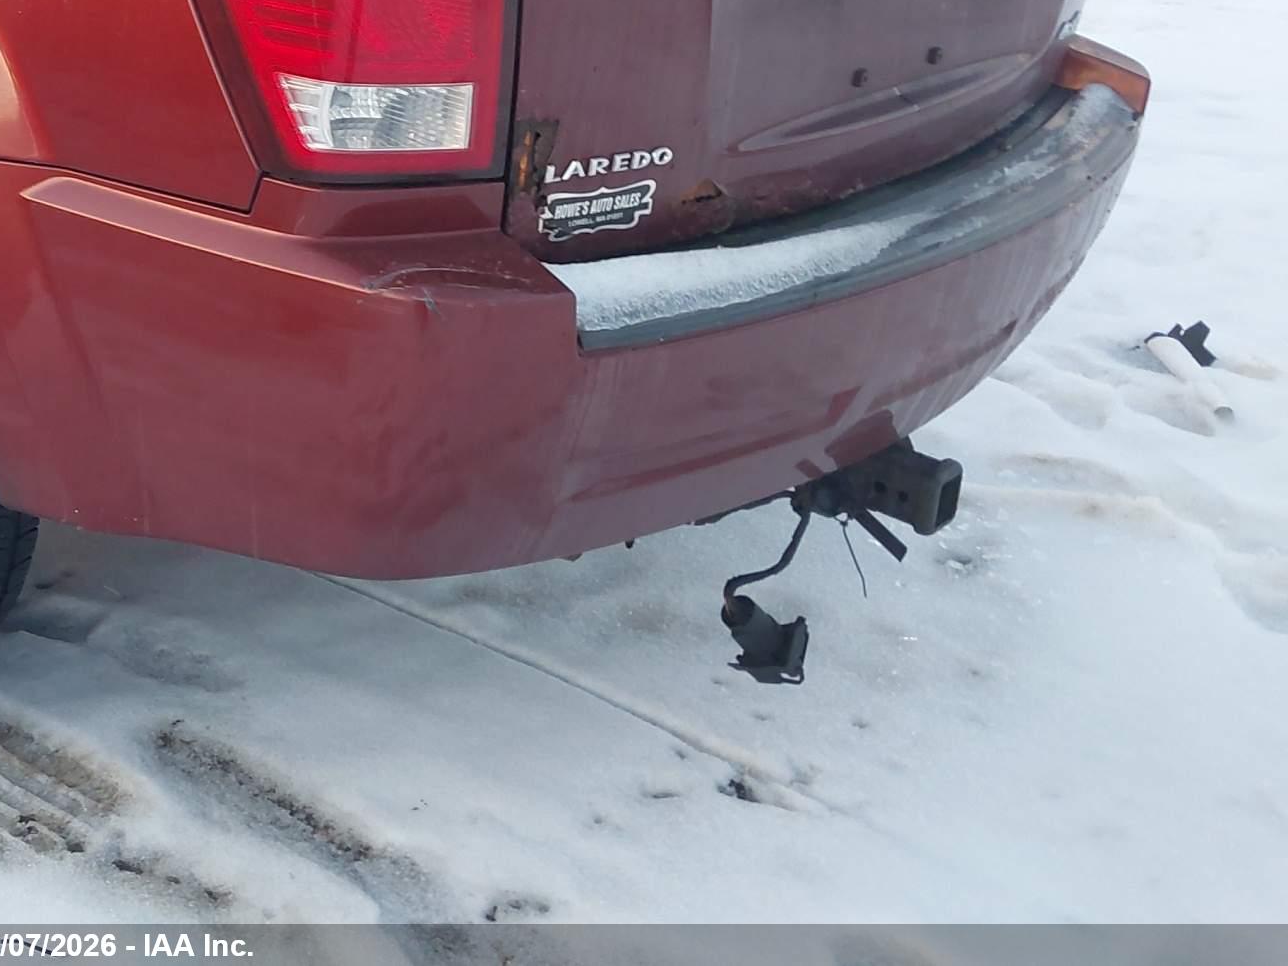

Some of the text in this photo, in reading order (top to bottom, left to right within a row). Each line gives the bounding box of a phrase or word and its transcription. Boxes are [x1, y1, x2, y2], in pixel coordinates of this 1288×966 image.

[543, 147, 674, 183] LAREDO
[554, 200, 590, 220] HOWE'S
[590, 196, 614, 215] AUTO
[613, 192, 642, 211] SALES
